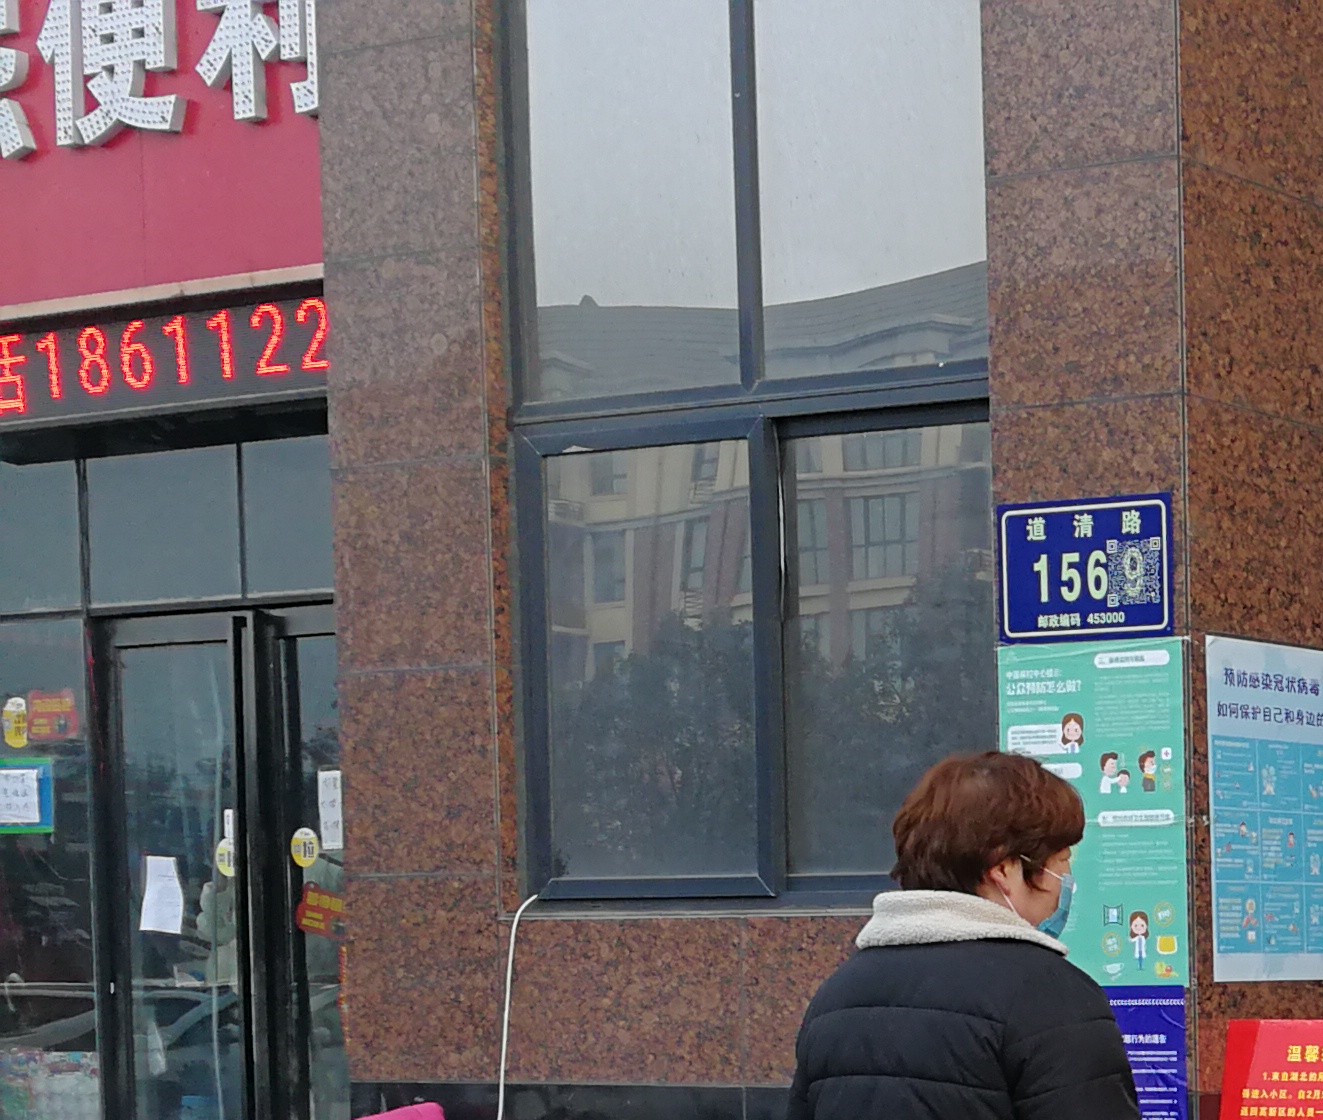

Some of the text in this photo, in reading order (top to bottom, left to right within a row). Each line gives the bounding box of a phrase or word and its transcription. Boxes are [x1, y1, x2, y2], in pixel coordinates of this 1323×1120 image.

[0, 0, 318, 160] 便利
[1025, 509, 1142, 541] 道清路
[1086, 611, 1126, 626] 453000
